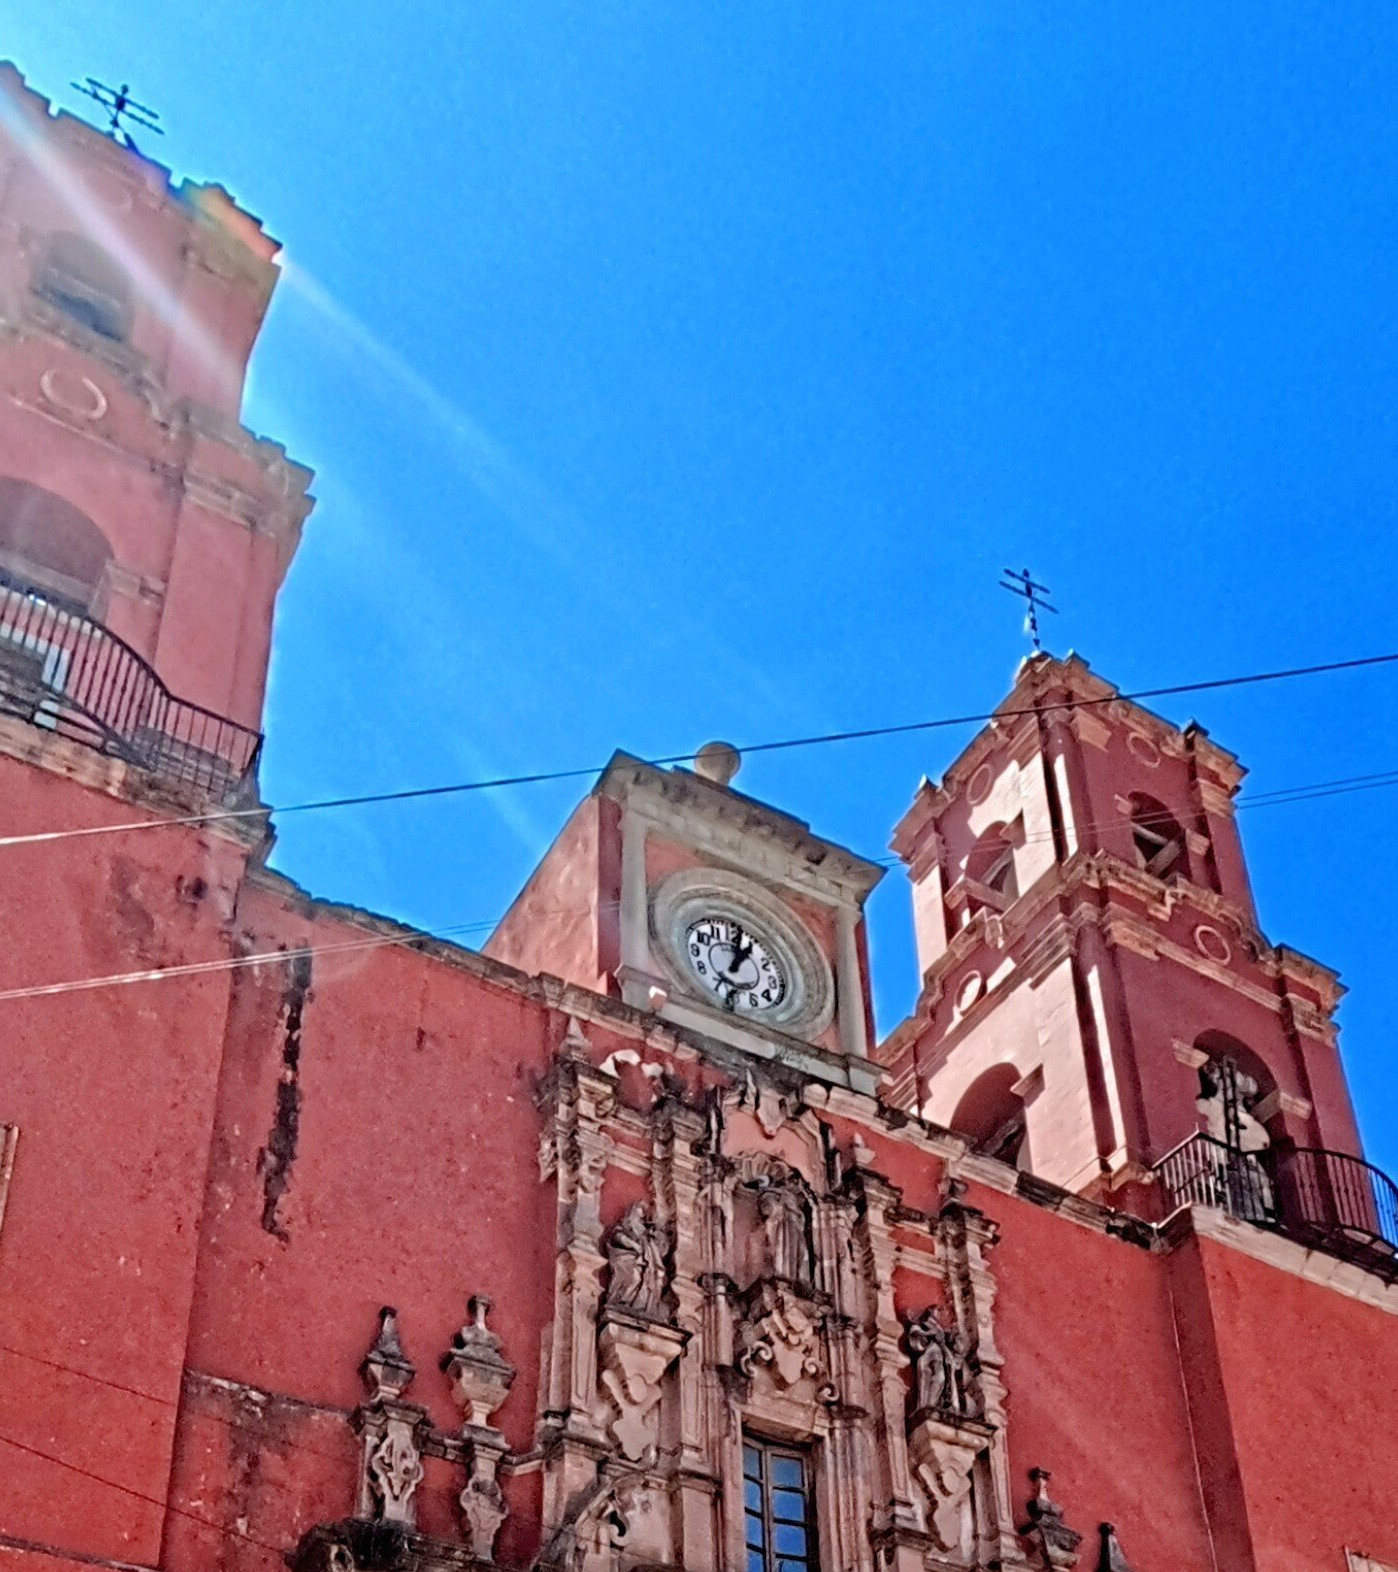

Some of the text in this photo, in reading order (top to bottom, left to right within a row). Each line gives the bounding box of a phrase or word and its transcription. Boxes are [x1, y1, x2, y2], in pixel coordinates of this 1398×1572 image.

[696, 930, 711, 946] 10
[691, 943, 700, 957] 9
[697, 960, 707, 975] 8
[760, 957, 771, 972] 2
[761, 989, 772, 1002] 4
